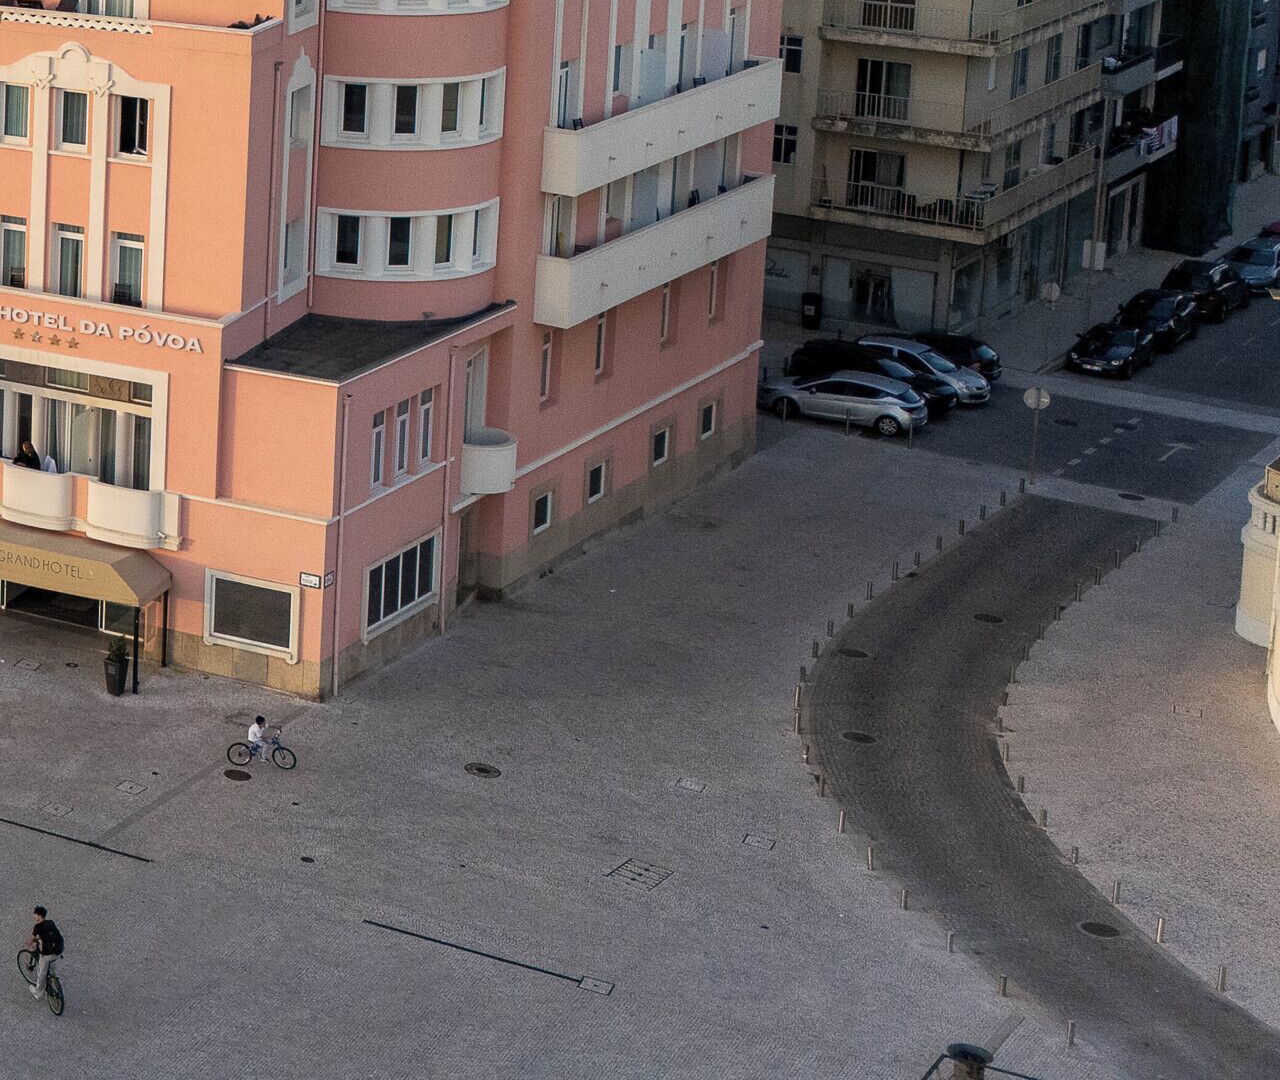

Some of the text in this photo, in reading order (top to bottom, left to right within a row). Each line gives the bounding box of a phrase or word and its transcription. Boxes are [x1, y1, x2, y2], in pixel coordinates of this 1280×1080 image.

[79, 319, 112, 339] DA
[119, 324, 203, 354] PÓVOA
[42, 559, 83, 579] HOTEL
